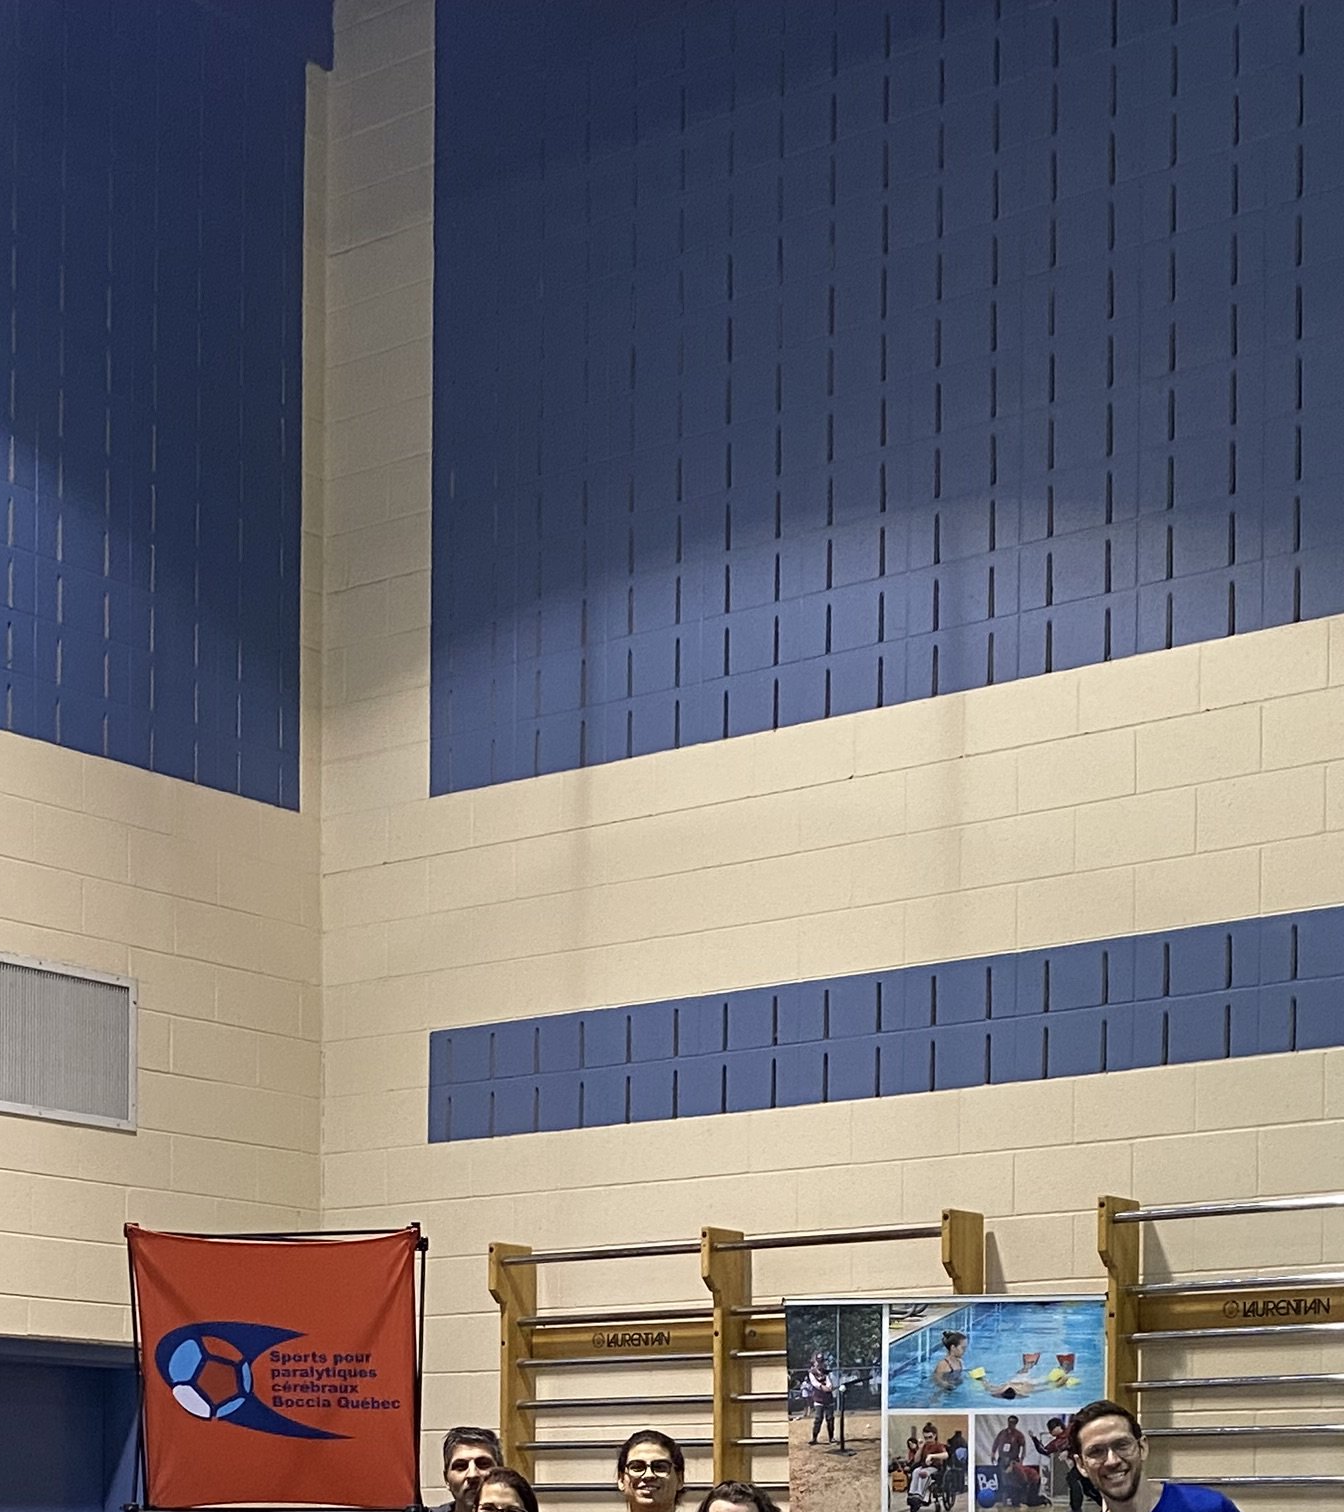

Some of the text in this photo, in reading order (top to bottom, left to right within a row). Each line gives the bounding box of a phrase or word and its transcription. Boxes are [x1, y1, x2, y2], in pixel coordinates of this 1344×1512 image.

[1242, 1298, 1331, 1318] LAURENTIAN
[607, 1331, 671, 1348] LAURENTIAN
[270, 1350, 371, 1366] Sports pour
[271, 1366, 377, 1381] paralytiques
[271, 1381, 359, 1394] cérébraux
[272, 1395, 401, 1410] Boccia Québec
